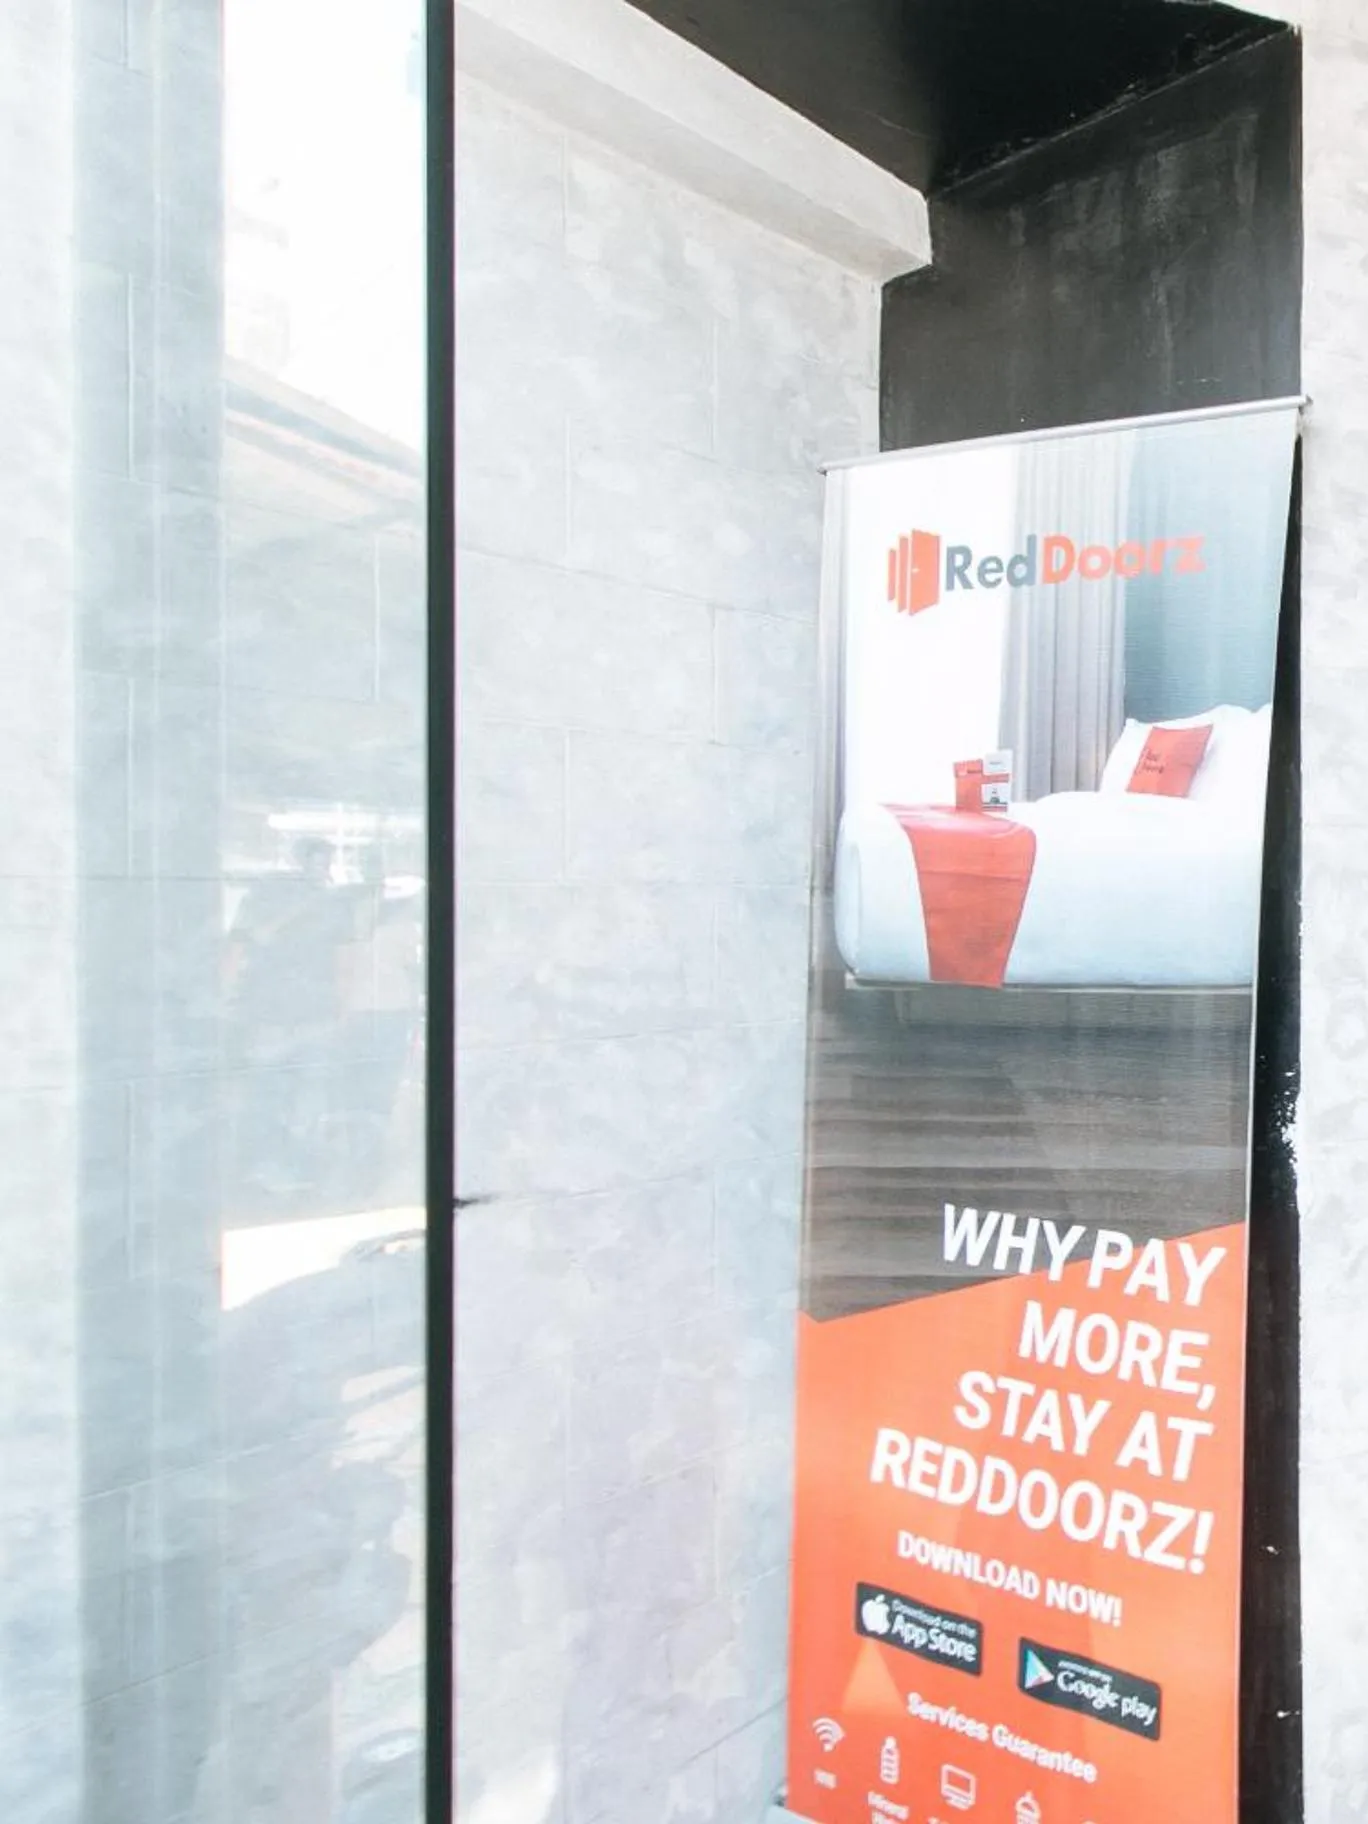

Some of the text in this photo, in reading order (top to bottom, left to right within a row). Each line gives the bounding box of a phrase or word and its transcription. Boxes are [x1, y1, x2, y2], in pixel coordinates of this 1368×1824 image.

[944, 533, 1207, 593] RedDoorz
[943, 1202, 1227, 1306] WHY PAY
[1018, 1300, 1217, 1411] MORE,
[953, 1370, 1214, 1483] STAY AT
[869, 1426, 1215, 1575] REDDOORZ!
[897, 1530, 1124, 1627] DOWNLOAD NOW!
[891, 1614, 978, 1663] App Store
[906, 1691, 1098, 1784] Services Guarantee
[1056, 1669, 1121, 1710] Google
[1120, 1695, 1158, 1727] play
